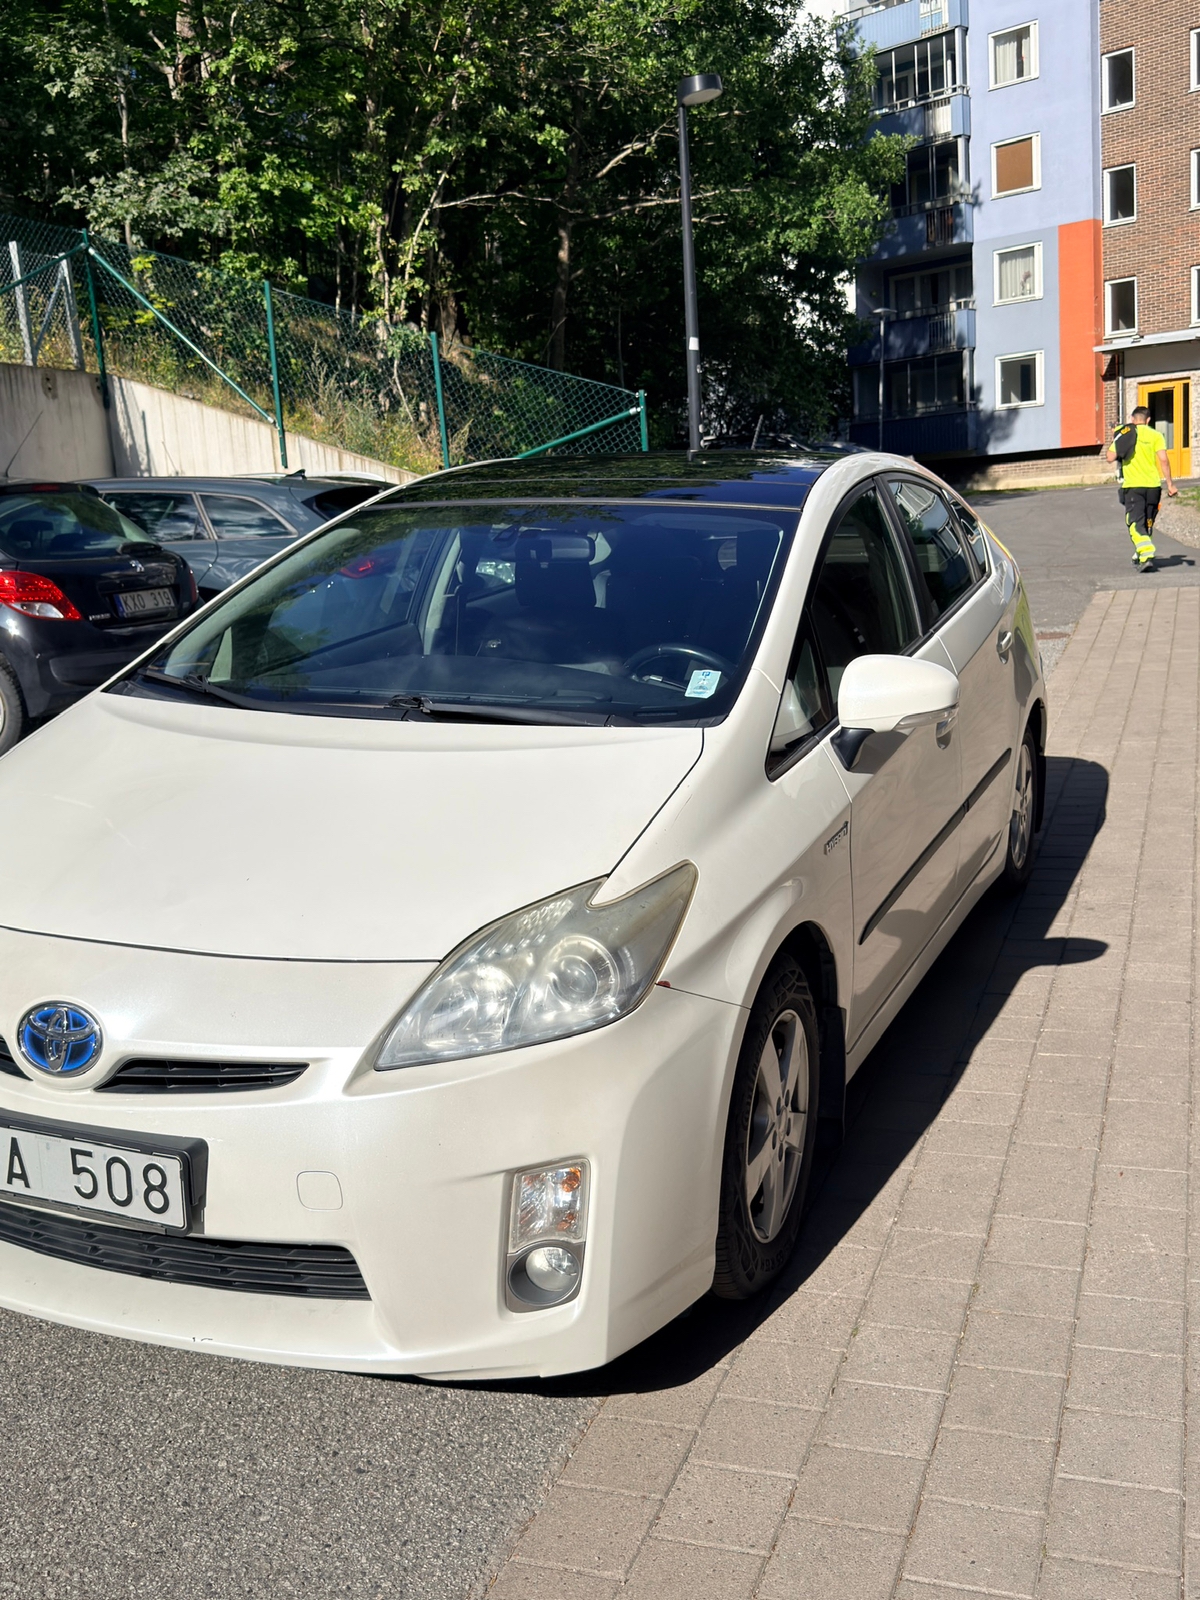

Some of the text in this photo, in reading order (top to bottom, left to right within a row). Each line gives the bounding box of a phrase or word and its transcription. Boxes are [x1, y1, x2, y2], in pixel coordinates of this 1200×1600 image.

[121, 590, 172, 612] KXO 319
[7, 1136, 170, 1215] A 508
